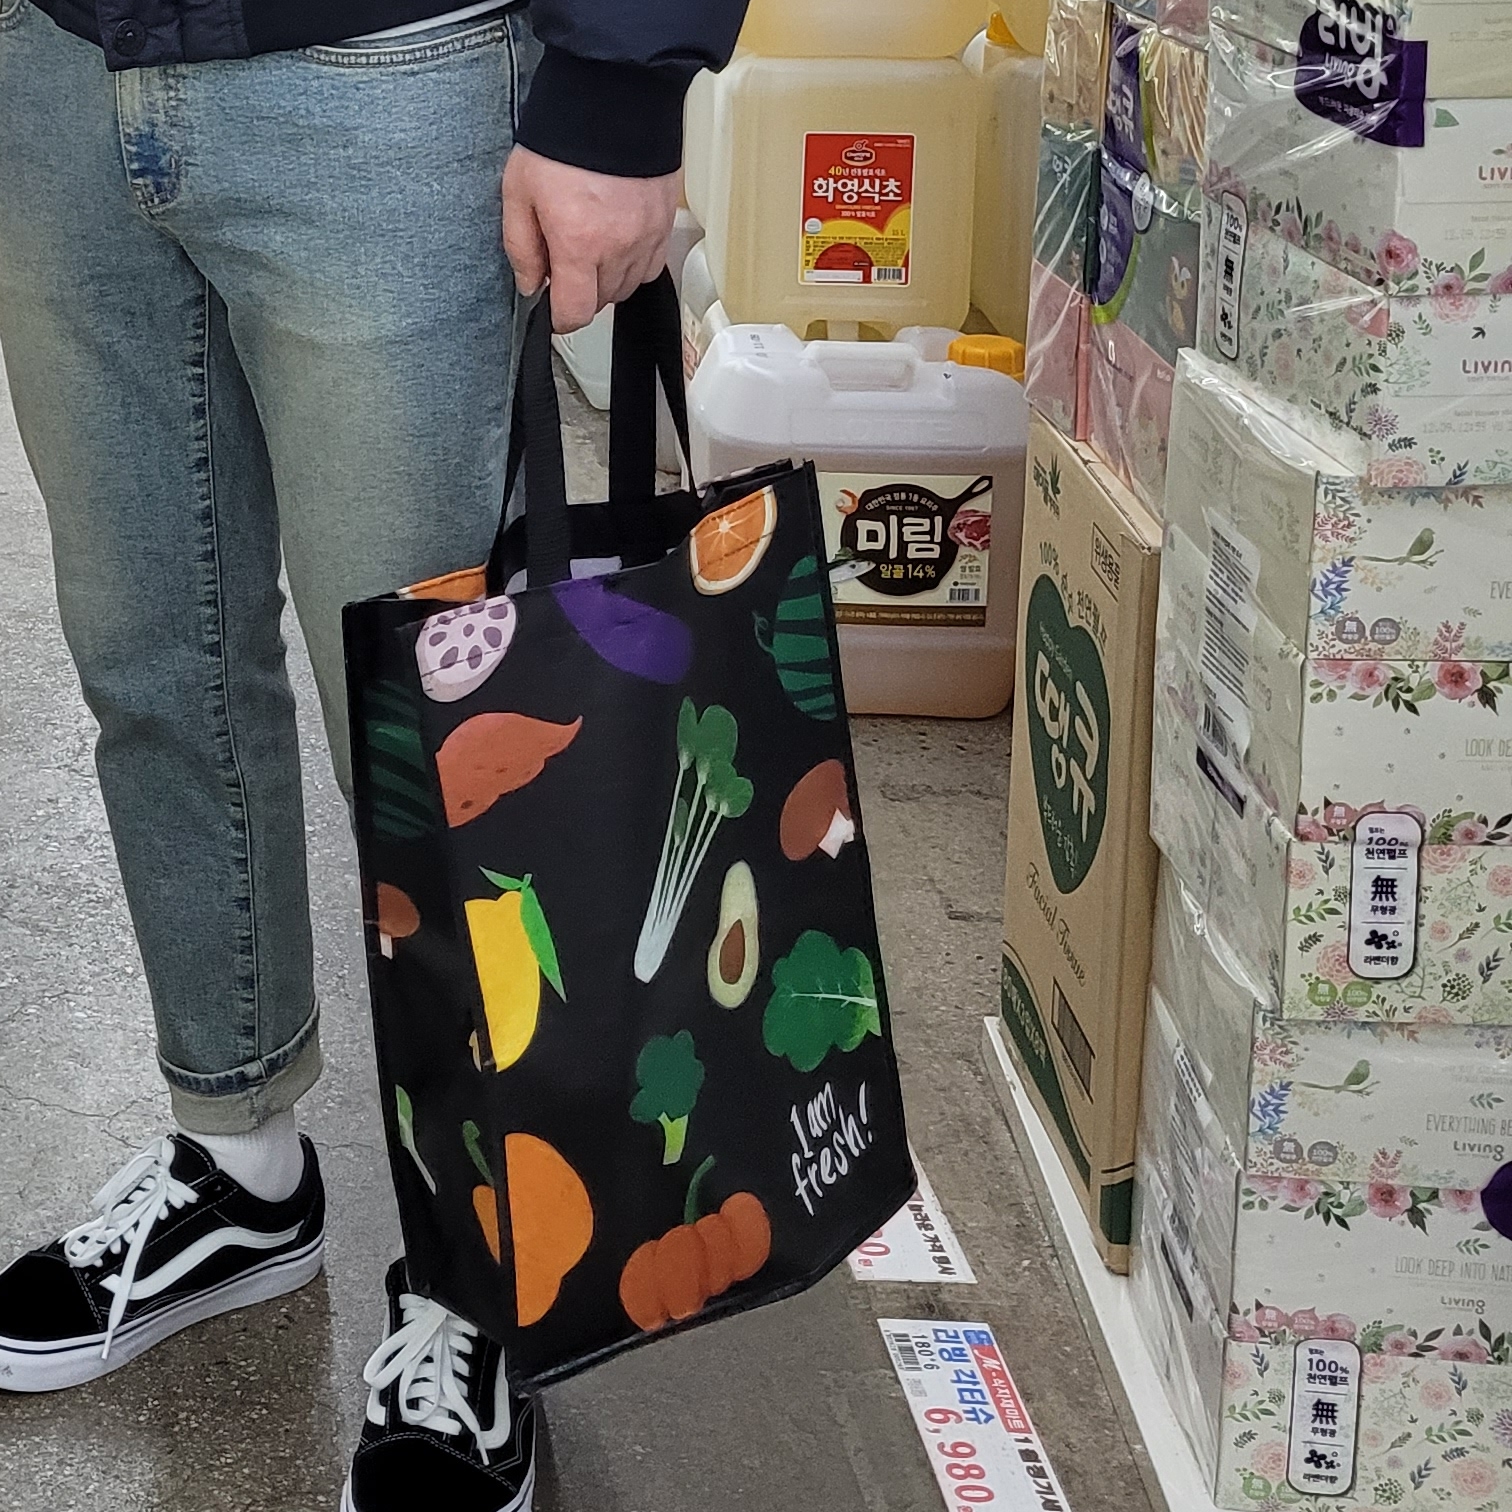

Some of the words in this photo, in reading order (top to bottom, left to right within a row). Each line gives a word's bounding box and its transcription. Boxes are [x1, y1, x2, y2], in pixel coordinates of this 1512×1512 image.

[812, 177, 903, 204] 화영식초
[856, 514, 943, 560] 미림
[879, 564, 905, 579] 알콜
[907, 564, 936, 579] 14%
[1364, 848, 1409, 861] 천연펄프
[1370, 874, 1399, 903] 無
[1370, 904, 1398, 916] 무형광
[790, 1104, 814, 1159] I
[806, 1081, 840, 1139] am
[1426, 1113, 1495, 1136] EVERYTHING
[790, 1080, 873, 1216] fresh!
[1395, 1256, 1424, 1274] LOOK
[1428, 1259, 1455, 1277] DEEP
[1460, 1262, 1487, 1280] INTO
[1440, 1295, 1486, 1315] Living
[931, 1327, 971, 1365] 리빙
[1306, 1357, 1350, 1375] 100%
[1305, 1372, 1350, 1386] 천연펄프
[948, 1369, 995, 1426] 각티슈
[1310, 1398, 1339, 1426] 無
